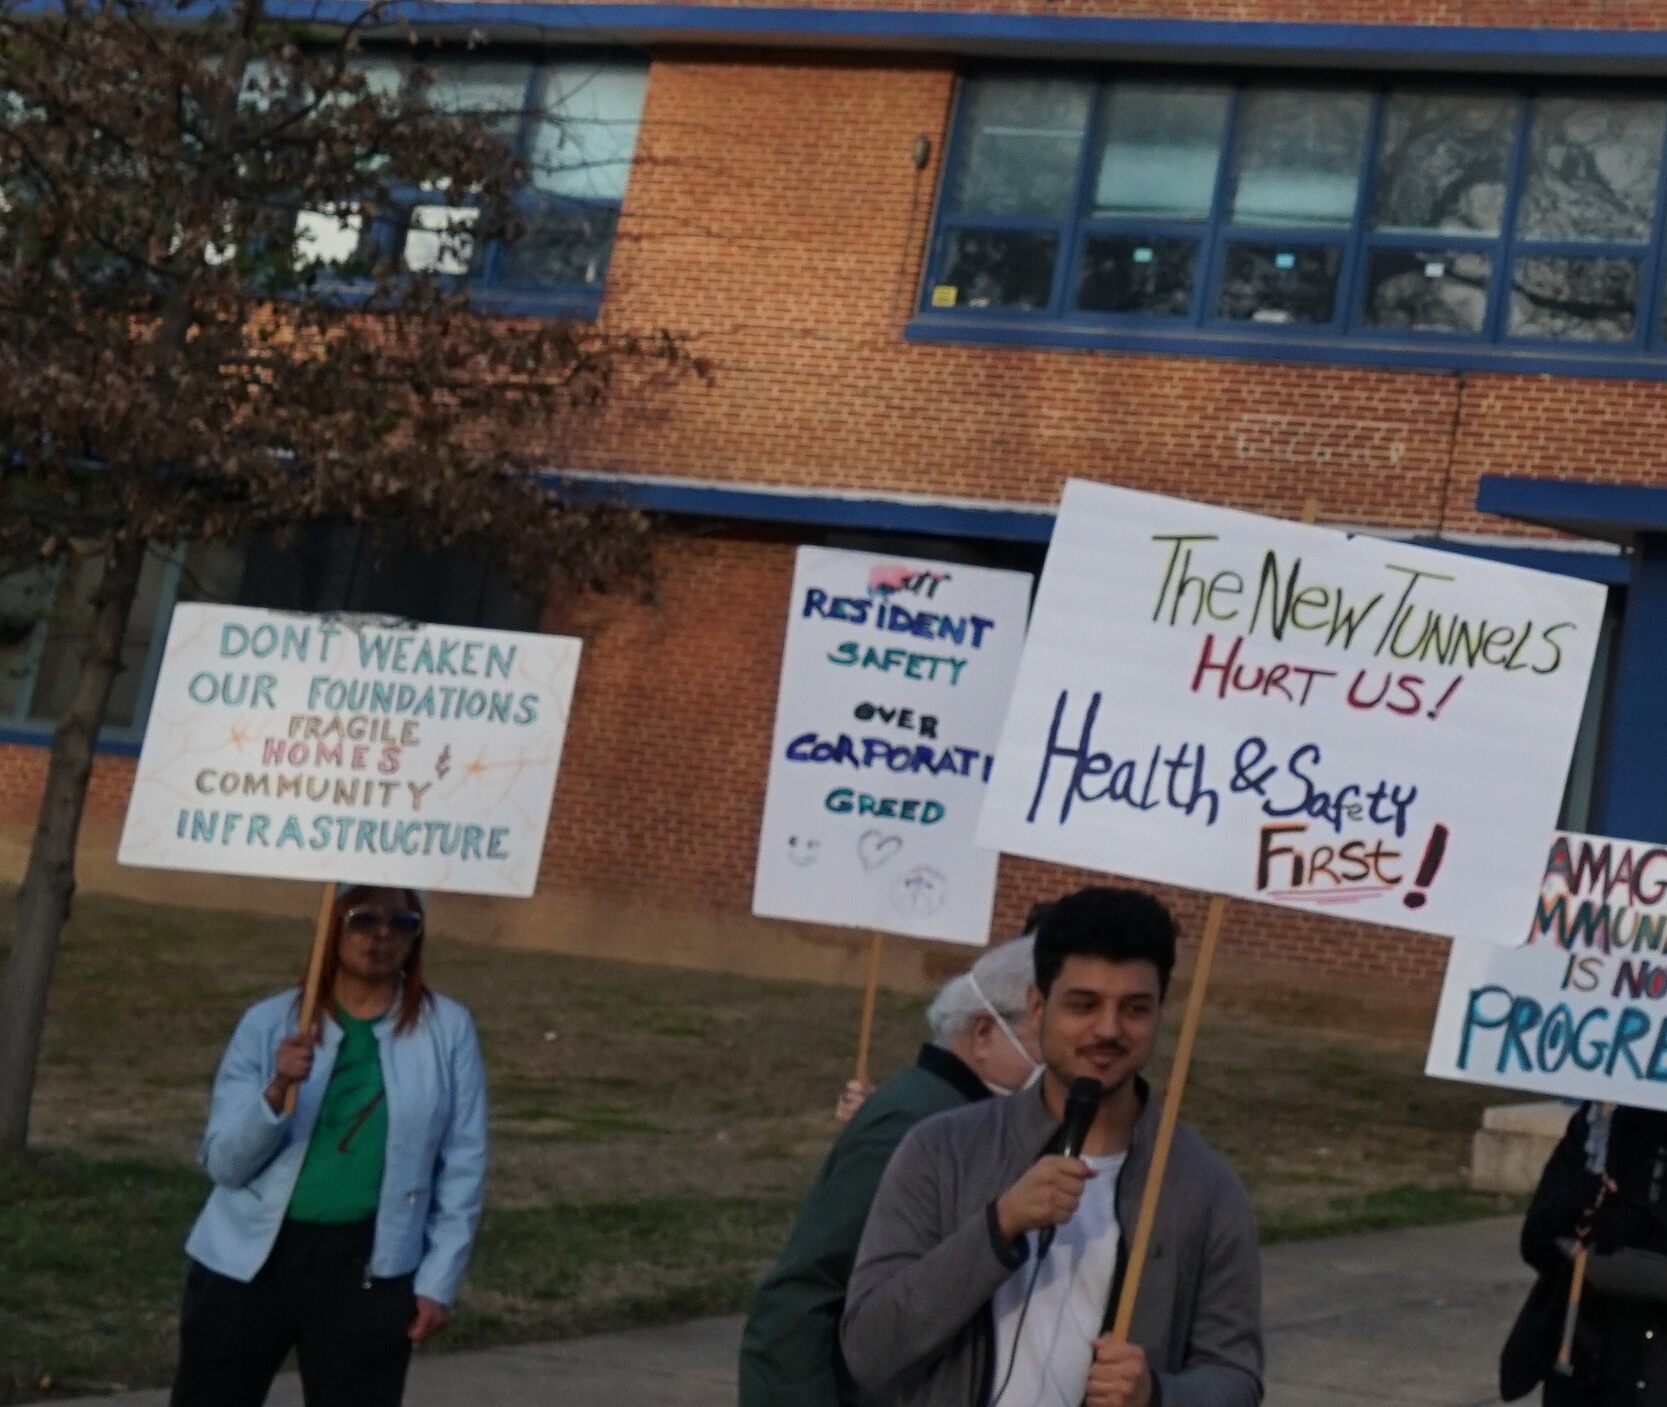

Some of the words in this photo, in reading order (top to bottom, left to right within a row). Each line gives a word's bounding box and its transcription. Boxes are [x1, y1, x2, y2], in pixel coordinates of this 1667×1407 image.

[1152, 532, 1243, 627] The
[1248, 549, 1384, 652] New
[803, 587, 995, 649] RESIDENT
[219, 621, 341, 662] DONT
[358, 631, 517, 679] WEAKEN
[827, 641, 967, 686] SAFETY
[187, 672, 277, 711] OUR
[307, 674, 540, 726] FOUNDATIONS
[1191, 633, 1337, 706] HURT
[1346, 669, 1464, 721] US!
[287, 713, 422, 747] FRAGILE
[854, 702, 939, 739] OVER
[261, 737, 402, 775] HOMES
[1026, 689, 1220, 826] Health
[1229, 736, 1279, 798] &
[1261, 743, 1418, 838] Safety
[194, 767, 432, 812] COMMUNITY
[825, 787, 945, 825] GREED
[175, 807, 511, 862] INFRASTRUCTURE
[1561, 953, 1604, 993] IS
